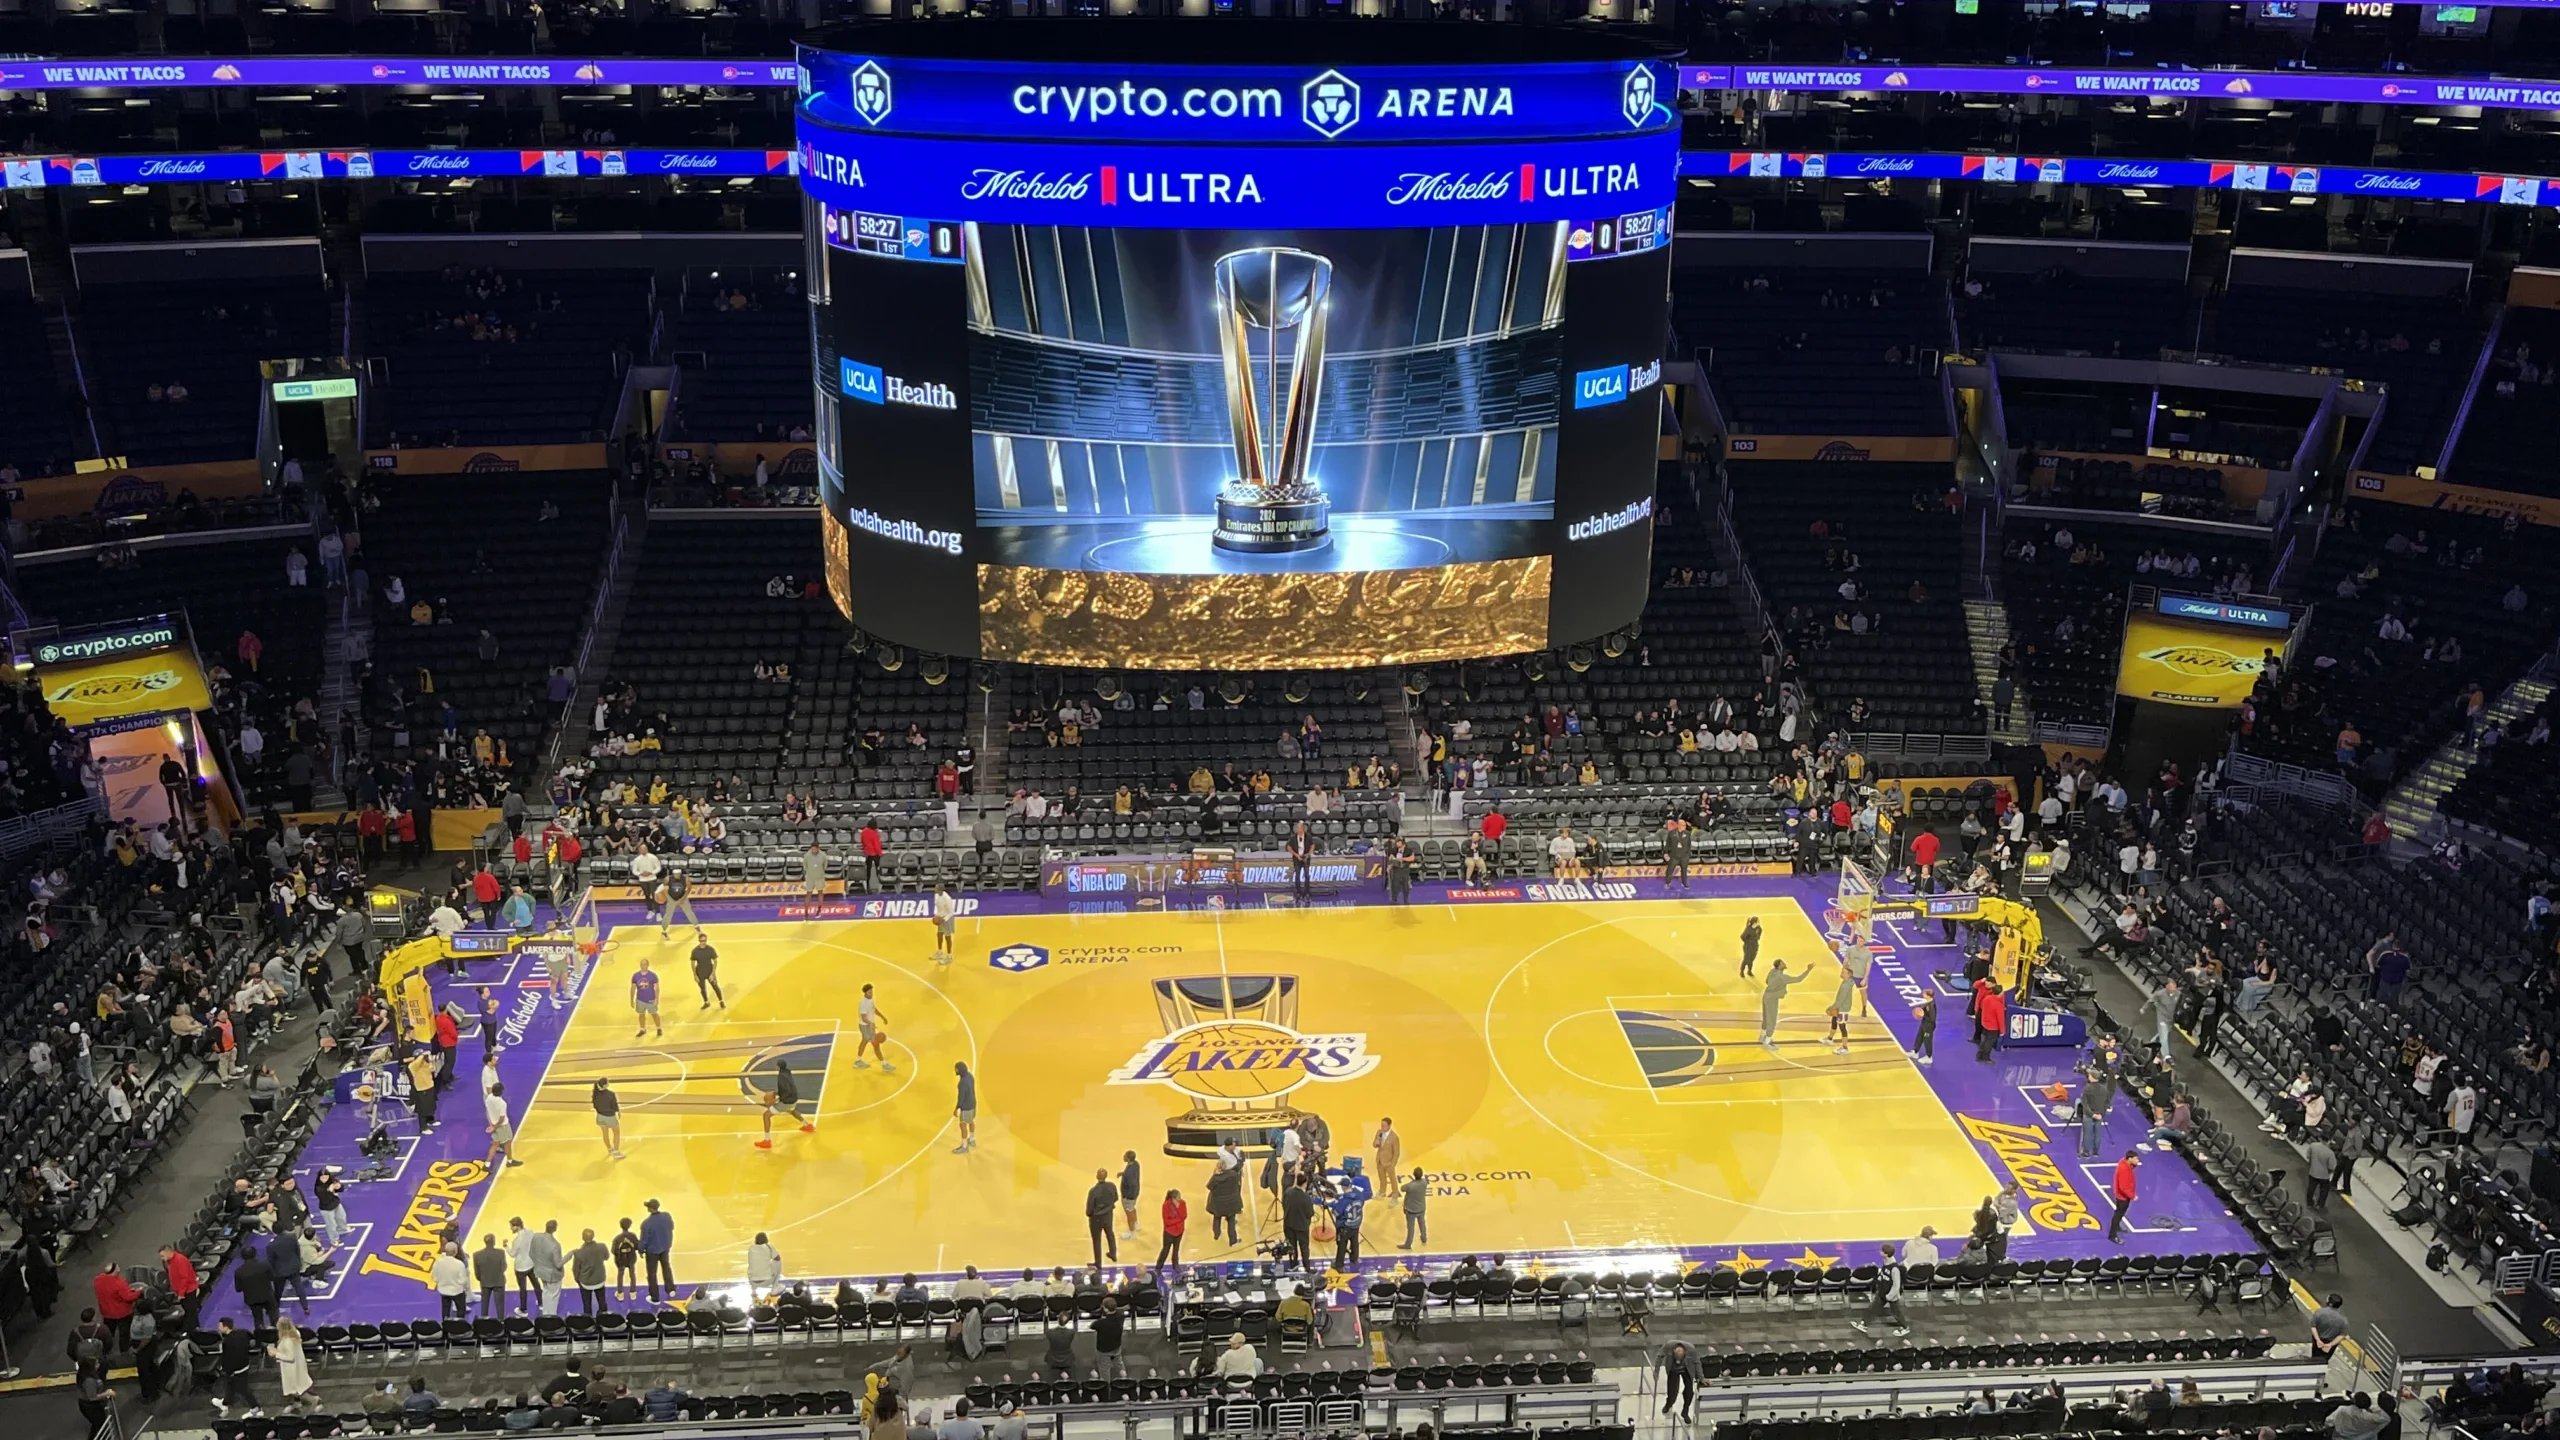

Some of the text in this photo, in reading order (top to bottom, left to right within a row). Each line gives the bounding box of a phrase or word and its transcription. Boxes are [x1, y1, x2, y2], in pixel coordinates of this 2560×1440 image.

[2346, 3, 2393, 18] HYDE
[43, 66, 186, 82] WE WANT TACOS
[423, 65, 551, 79] WE WANT TACOS
[771, 67, 796, 80] WE
[1746, 72, 1862, 85] WE WANT TACOS
[2075, 76, 2200, 91] WE WANT TACOS
[1013, 80, 1514, 122] crypto.com ARENA
[2437, 86, 2465, 100] WE
[2468, 88, 2519, 103] WANT
[139, 160, 206, 176] Michelob
[408, 155, 470, 169] Michelob
[659, 153, 718, 169] Michelob
[811, 149, 865, 187] ULTRA
[1857, 157, 1914, 172] Michelob
[2098, 163, 2158, 178] Michelob
[961, 168, 1263, 204] Michelob ULTRA
[1387, 171, 1514, 205] Michelob
[1544, 162, 1639, 197] ULTRA
[2354, 173, 2422, 191] Michelob
[840, 214, 849, 240] 0
[859, 215, 896, 238] 58:27
[1624, 214, 1653, 236] 58:27
[939, 226, 951, 253] 0
[1600, 223, 1610, 250] 0
[1642, 238, 1652, 249] 1ST
[882, 242, 899, 254] 1ST
[1583, 358, 1660, 399] UCLA Health
[288, 384, 346, 395] UCLA Health
[846, 367, 957, 409] UCLA Health
[1734, 441, 1755, 451] 103
[373, 457, 394, 468] 118
[2038, 456, 2060, 467] 104
[2358, 478, 2382, 490] 105
[1259, 509, 1276, 521] 2024
[1568, 495, 1652, 542] uclahealth.org
[850, 506, 963, 554] uclahealth.org
[1226, 519, 1262, 533] Emirates
[1276, 520, 1288, 533] CUP
[2179, 603, 2268, 623] Michelob ULTRA
[62, 628, 173, 657] crypto.com
[89, 724, 107, 737] 17x
[1695, 864, 1759, 875] LAKERS
[1082, 873, 1127, 892] NBA CUP
[1452, 882, 1637, 900] Emirates NBA CUP
[884, 898, 929, 917] NBA
[934, 897, 980, 916] UP
[1871, 911, 1915, 921] AKERS.COM
[522, 945, 575, 955] LAKERS.COM
[1058, 944, 1183, 956] crypto.com
[1059, 956, 1129, 965] ARENA
[1874, 954, 1927, 1008] ULTRA
[497, 989, 542, 1046] Michelob
[2042, 1014, 2058, 1025] JOIN
[2023, 1013, 2039, 1038] iD
[2042, 1025, 2063, 1037] TODAY
[1197, 1036, 1357, 1048] LOS ANGELES
[1120, 1041, 1362, 1082] LAKERS
[2463, 1099, 2474, 1111] 12
[1384, 1168, 1532, 1183] rpto.com
[1956, 1112, 2102, 1232] LAKERS
[1388, 1185, 1472, 1198] AENA
[359, 1159, 490, 1291] LAKERS
